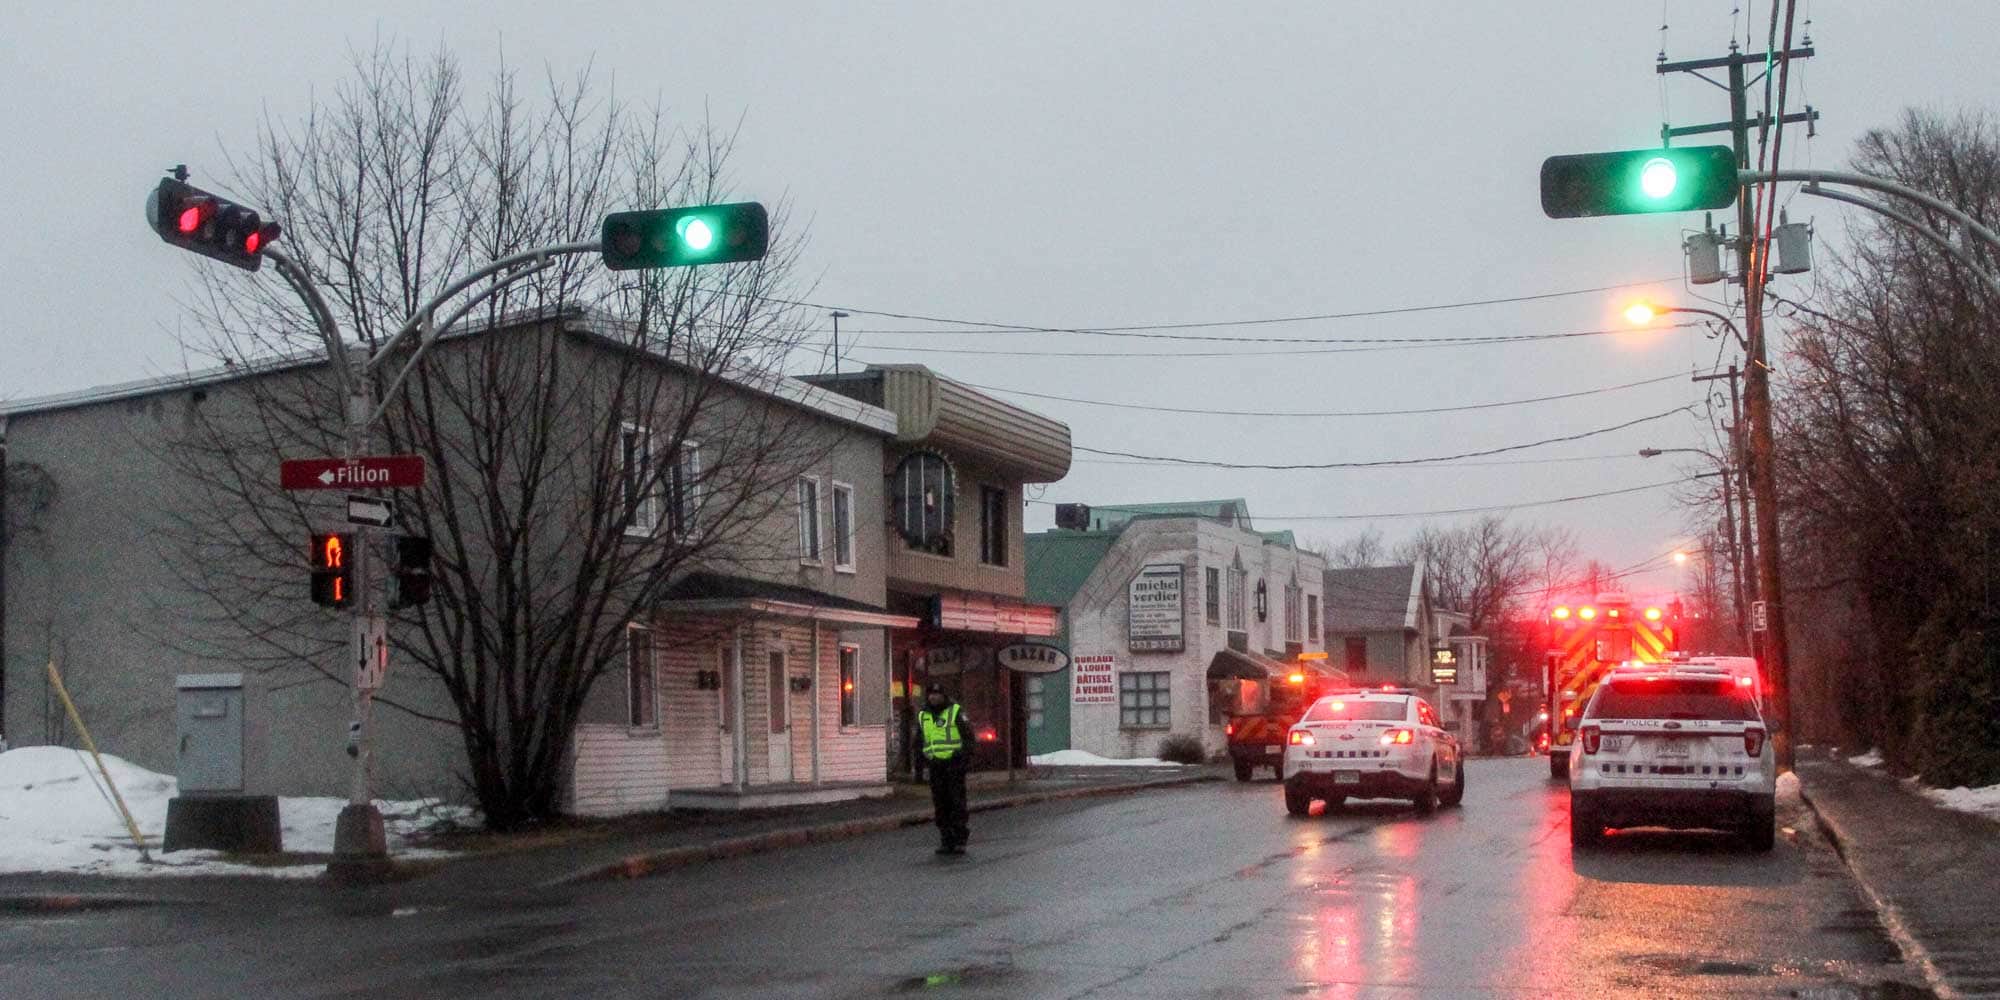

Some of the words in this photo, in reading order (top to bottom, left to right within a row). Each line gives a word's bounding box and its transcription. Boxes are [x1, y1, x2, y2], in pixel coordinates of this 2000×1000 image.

[338, 465, 389, 483] Filion
[1136, 579, 1178, 591] michel
[1134, 591, 1179, 602] verdier
[1009, 648, 1058, 664] BAZAR
[1082, 685, 1114, 694] VENDRE
[1626, 720, 1659, 728] POLICE
